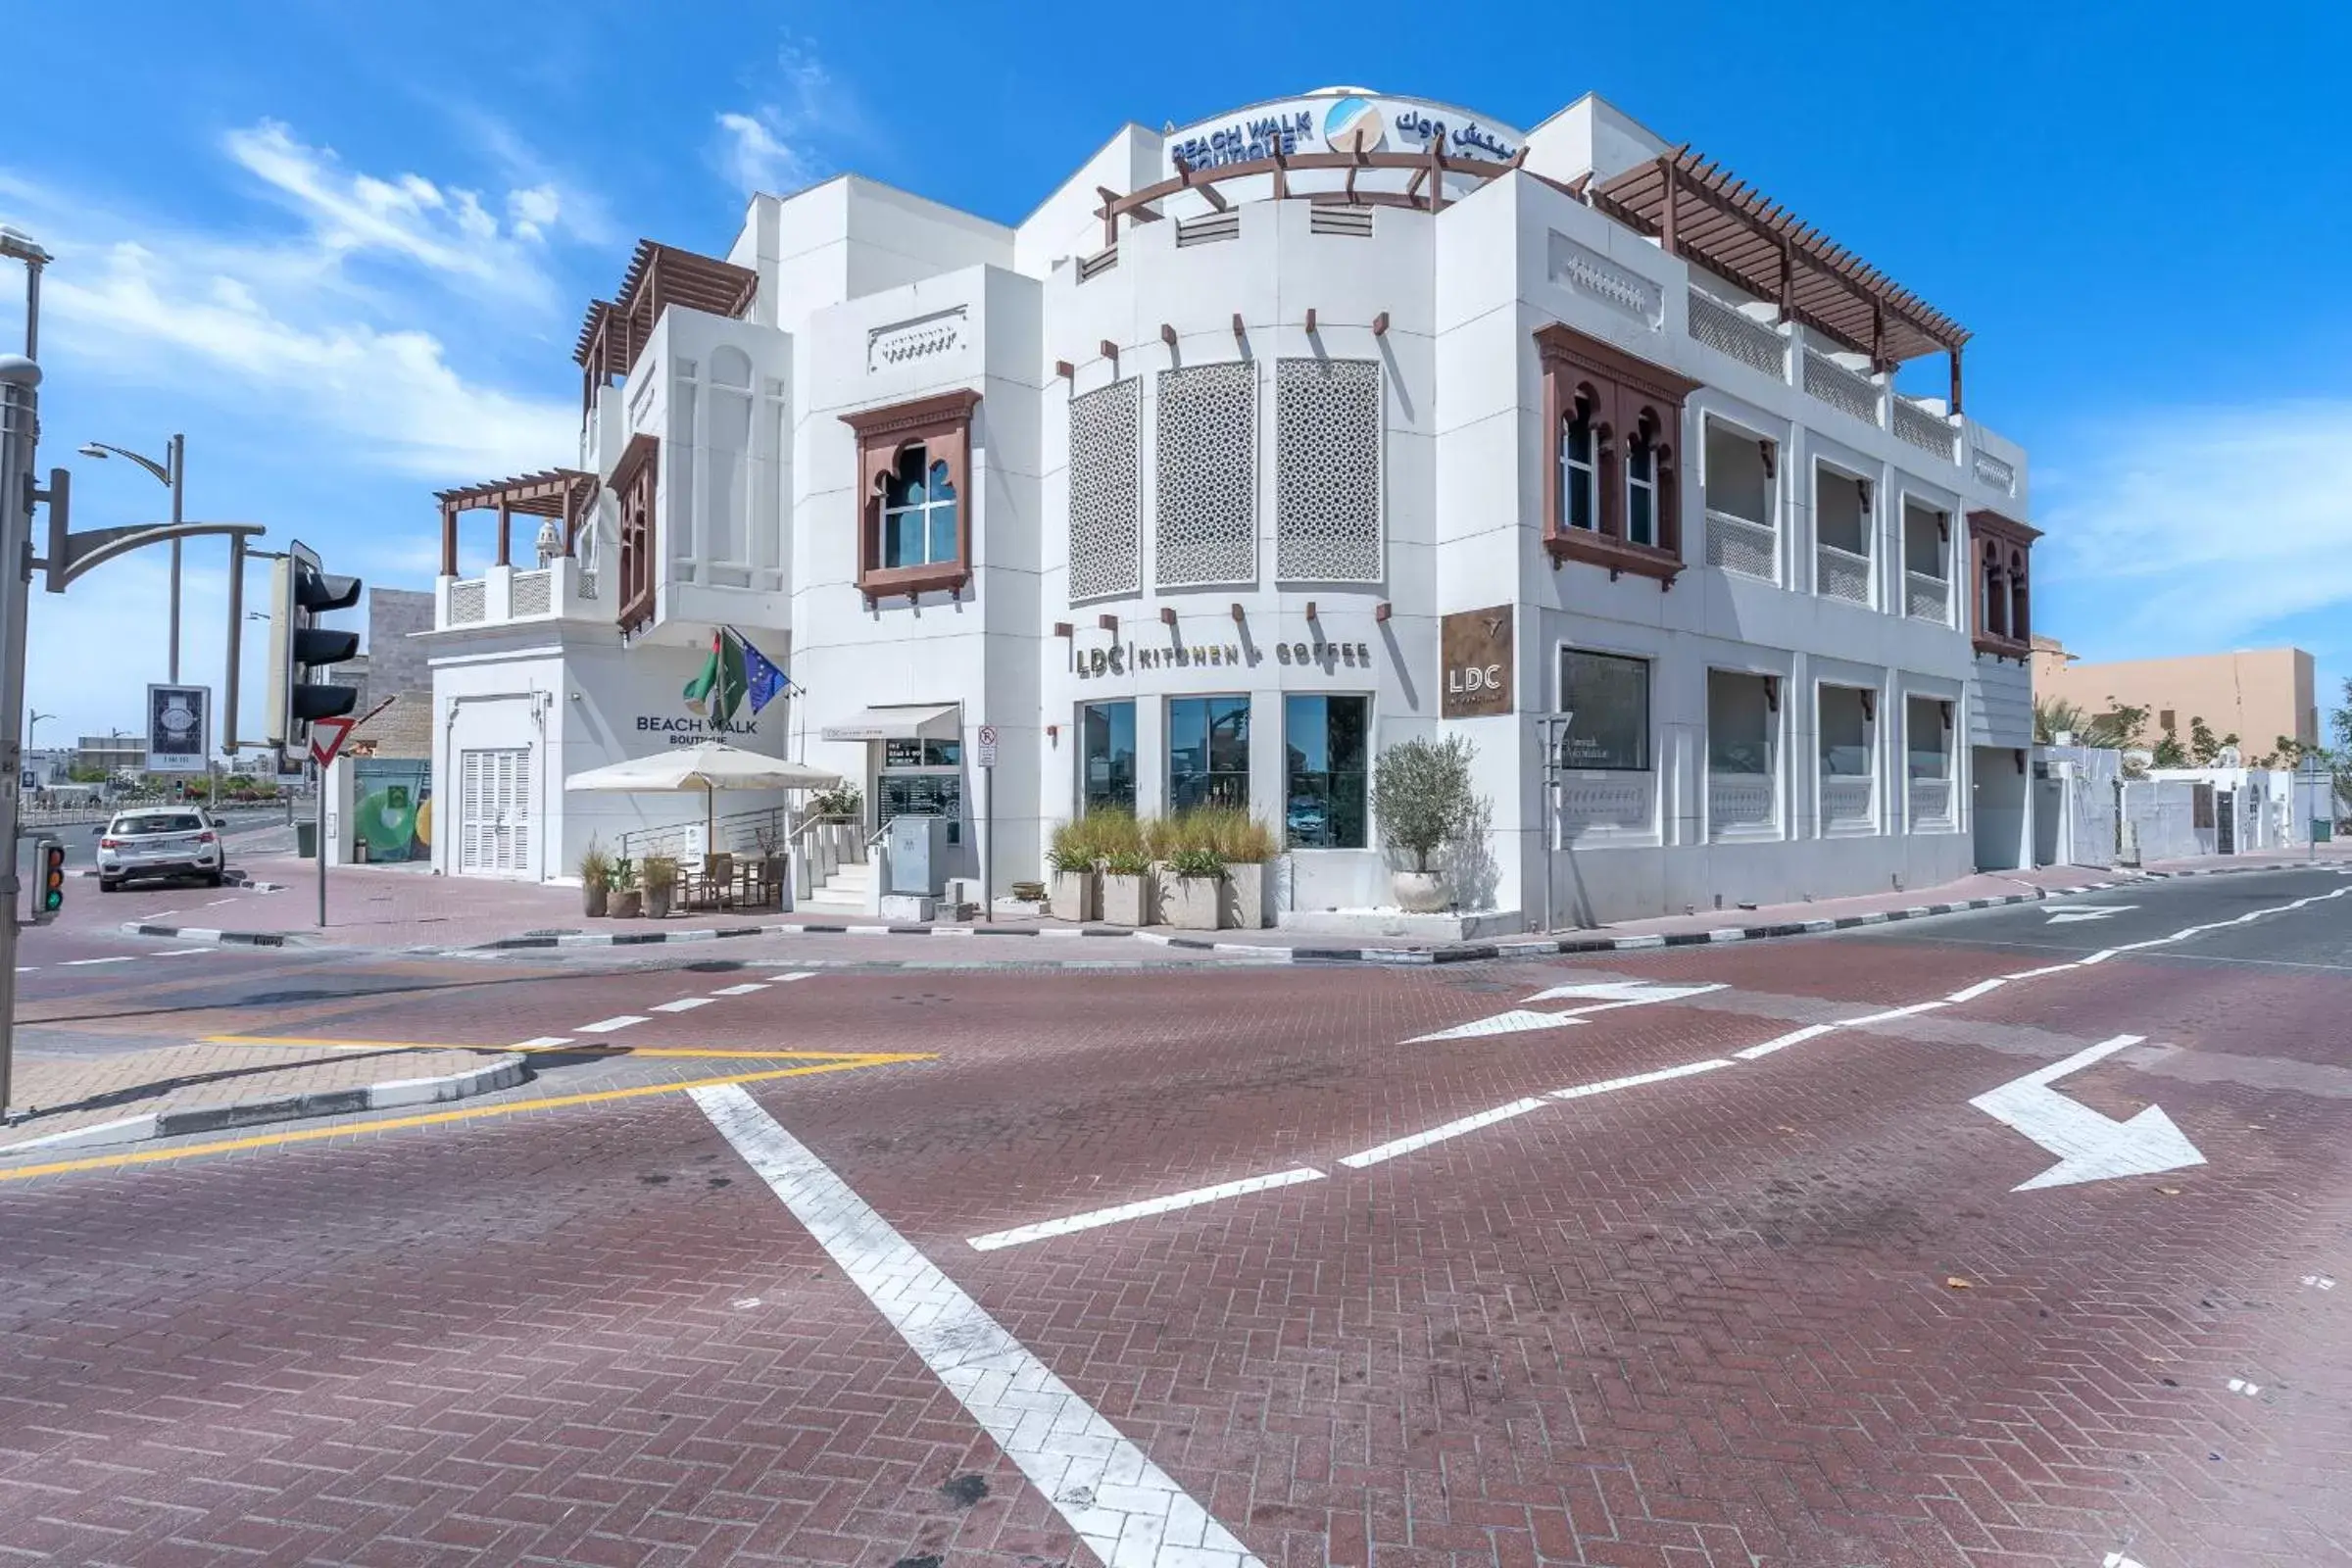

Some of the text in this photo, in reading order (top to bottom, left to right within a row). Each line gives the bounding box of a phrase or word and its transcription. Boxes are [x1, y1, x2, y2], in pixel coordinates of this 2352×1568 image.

[1172, 110, 1314, 164] BEACH WALK
[1076, 645, 1125, 677] LDC
[1275, 642, 1369, 663] COFFEE
[1449, 664, 1501, 694] LDC
[636, 716, 759, 734] BEACH WALK
[669, 735, 727, 745] BOUTIUE
